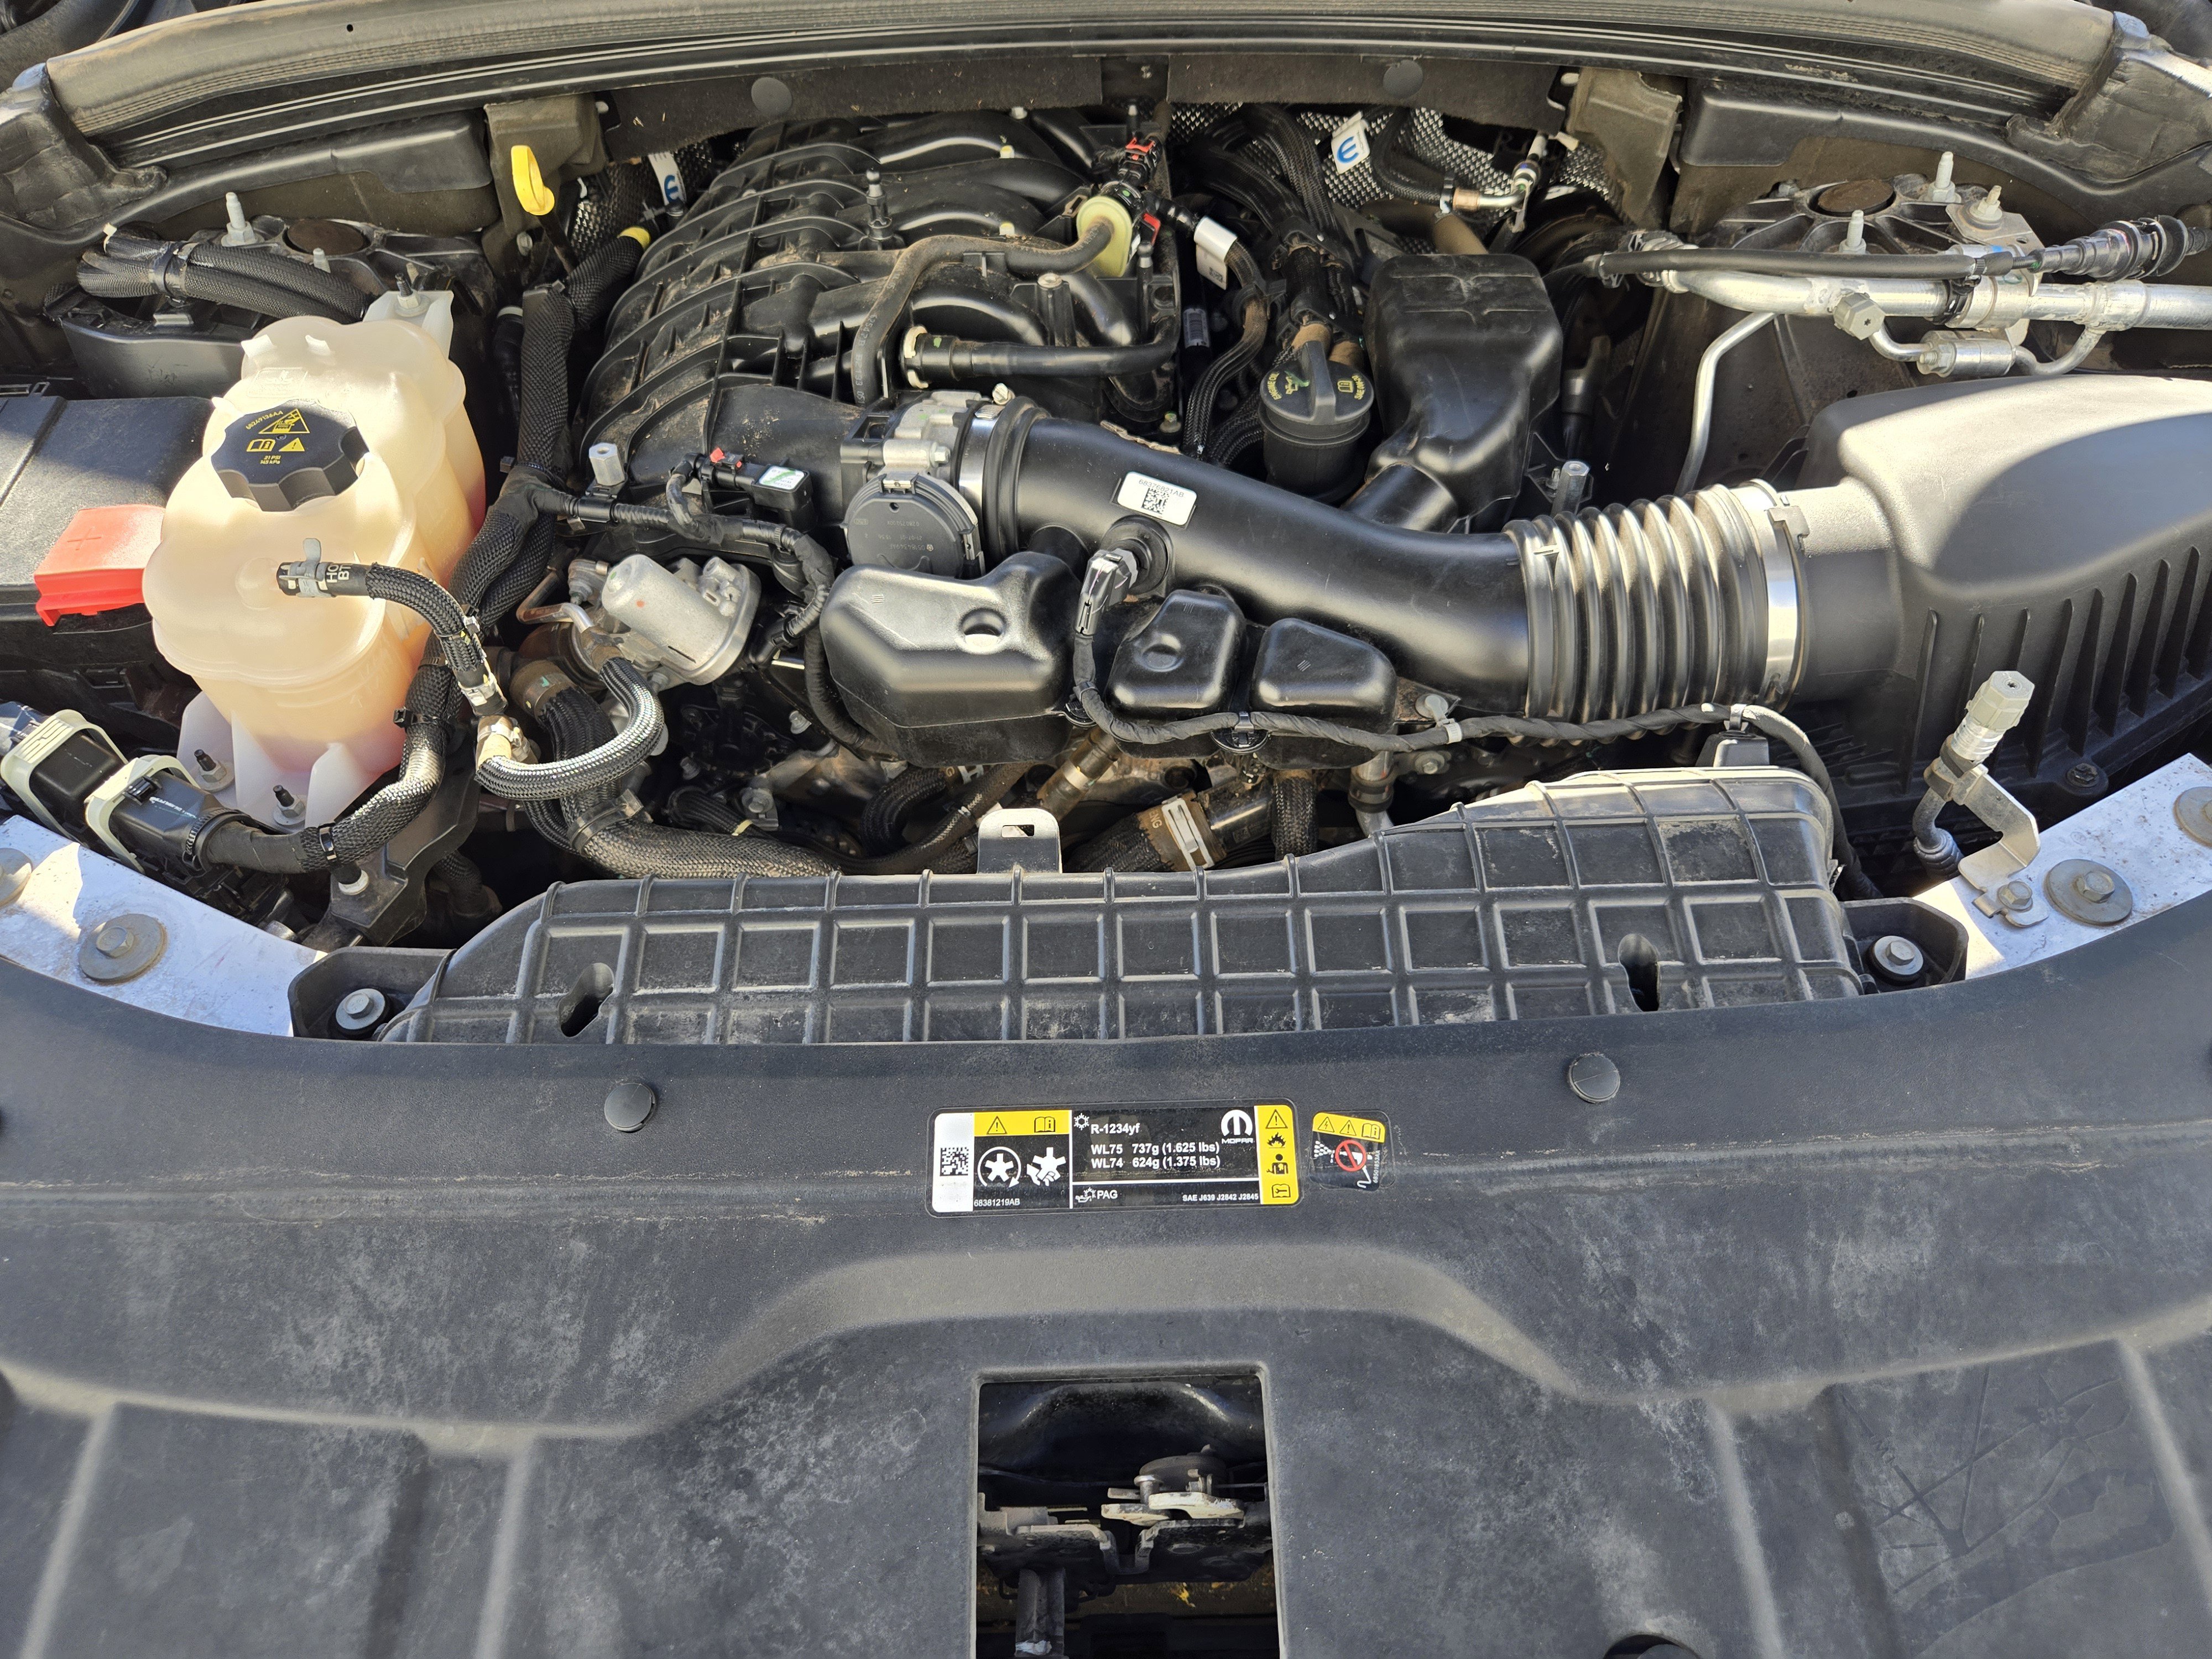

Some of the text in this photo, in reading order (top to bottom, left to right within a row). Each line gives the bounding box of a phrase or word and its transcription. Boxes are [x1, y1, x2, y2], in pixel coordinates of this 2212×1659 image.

[1138, 479, 1185, 498] 68376821AB
[1149, 810, 1162, 828] ENG
[1091, 1123, 1140, 1136] R-1234yf
[1091, 1141, 1220, 1156] WL75 737g (1.625 lbs)
[1091, 1155, 1221, 1170] WL74 624g (1.375 lbs)
[974, 1198, 1020, 1207] 68381219AB
[1097, 1190, 1118, 1200] PAG
